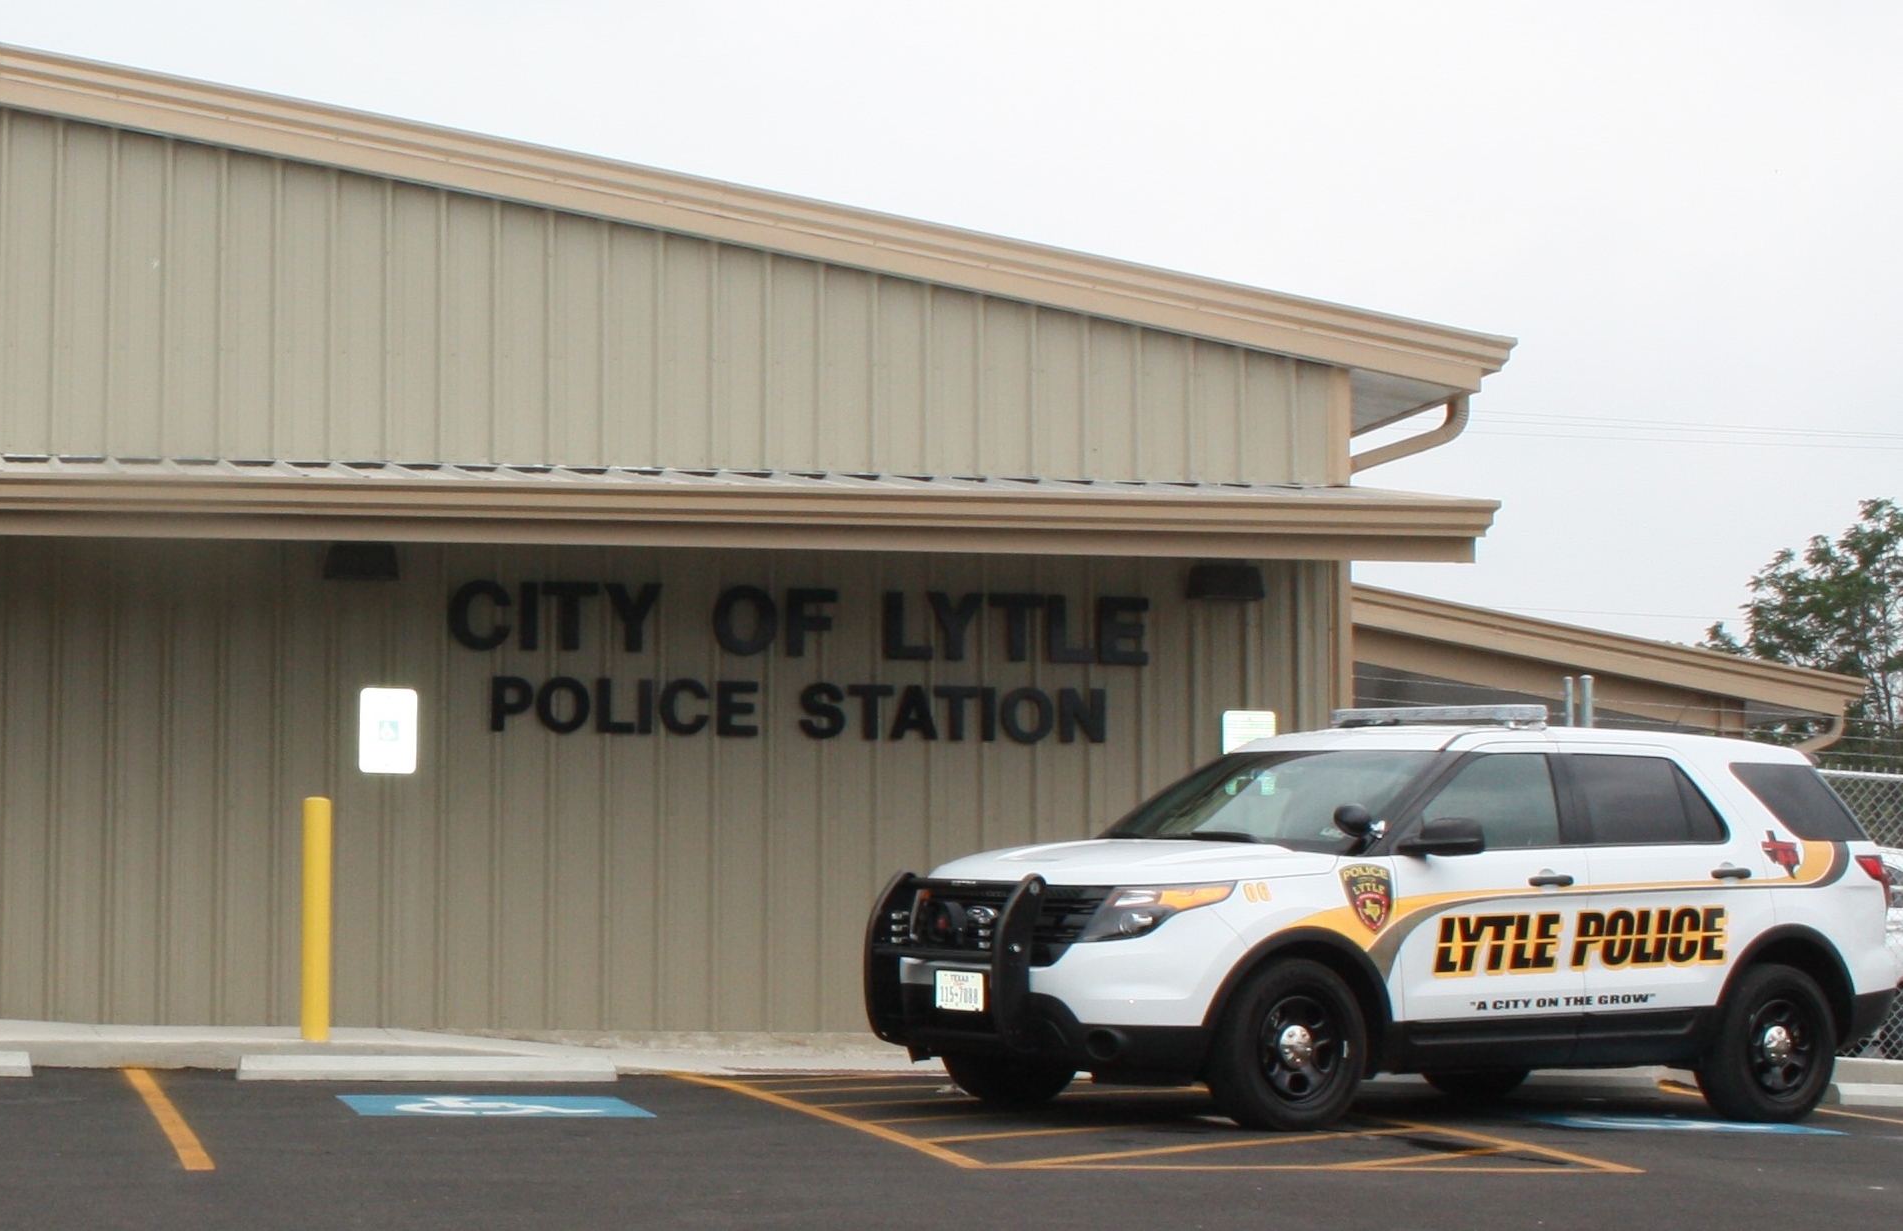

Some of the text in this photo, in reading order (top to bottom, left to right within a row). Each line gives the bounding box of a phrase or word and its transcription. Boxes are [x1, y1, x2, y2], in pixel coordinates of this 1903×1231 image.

[447, 579, 1150, 666] CITY OF LYTLE
[490, 676, 1106, 744] POLICE STATION
[1343, 867, 1388, 881] POLICE
[1352, 883, 1385, 895] LYTLE
[1431, 905, 1728, 979] LYTLE POLICE
[1493, 998, 1530, 1011] CITY
[1536, 997, 1559, 1009] ON
[1564, 995, 1593, 1007] THE
